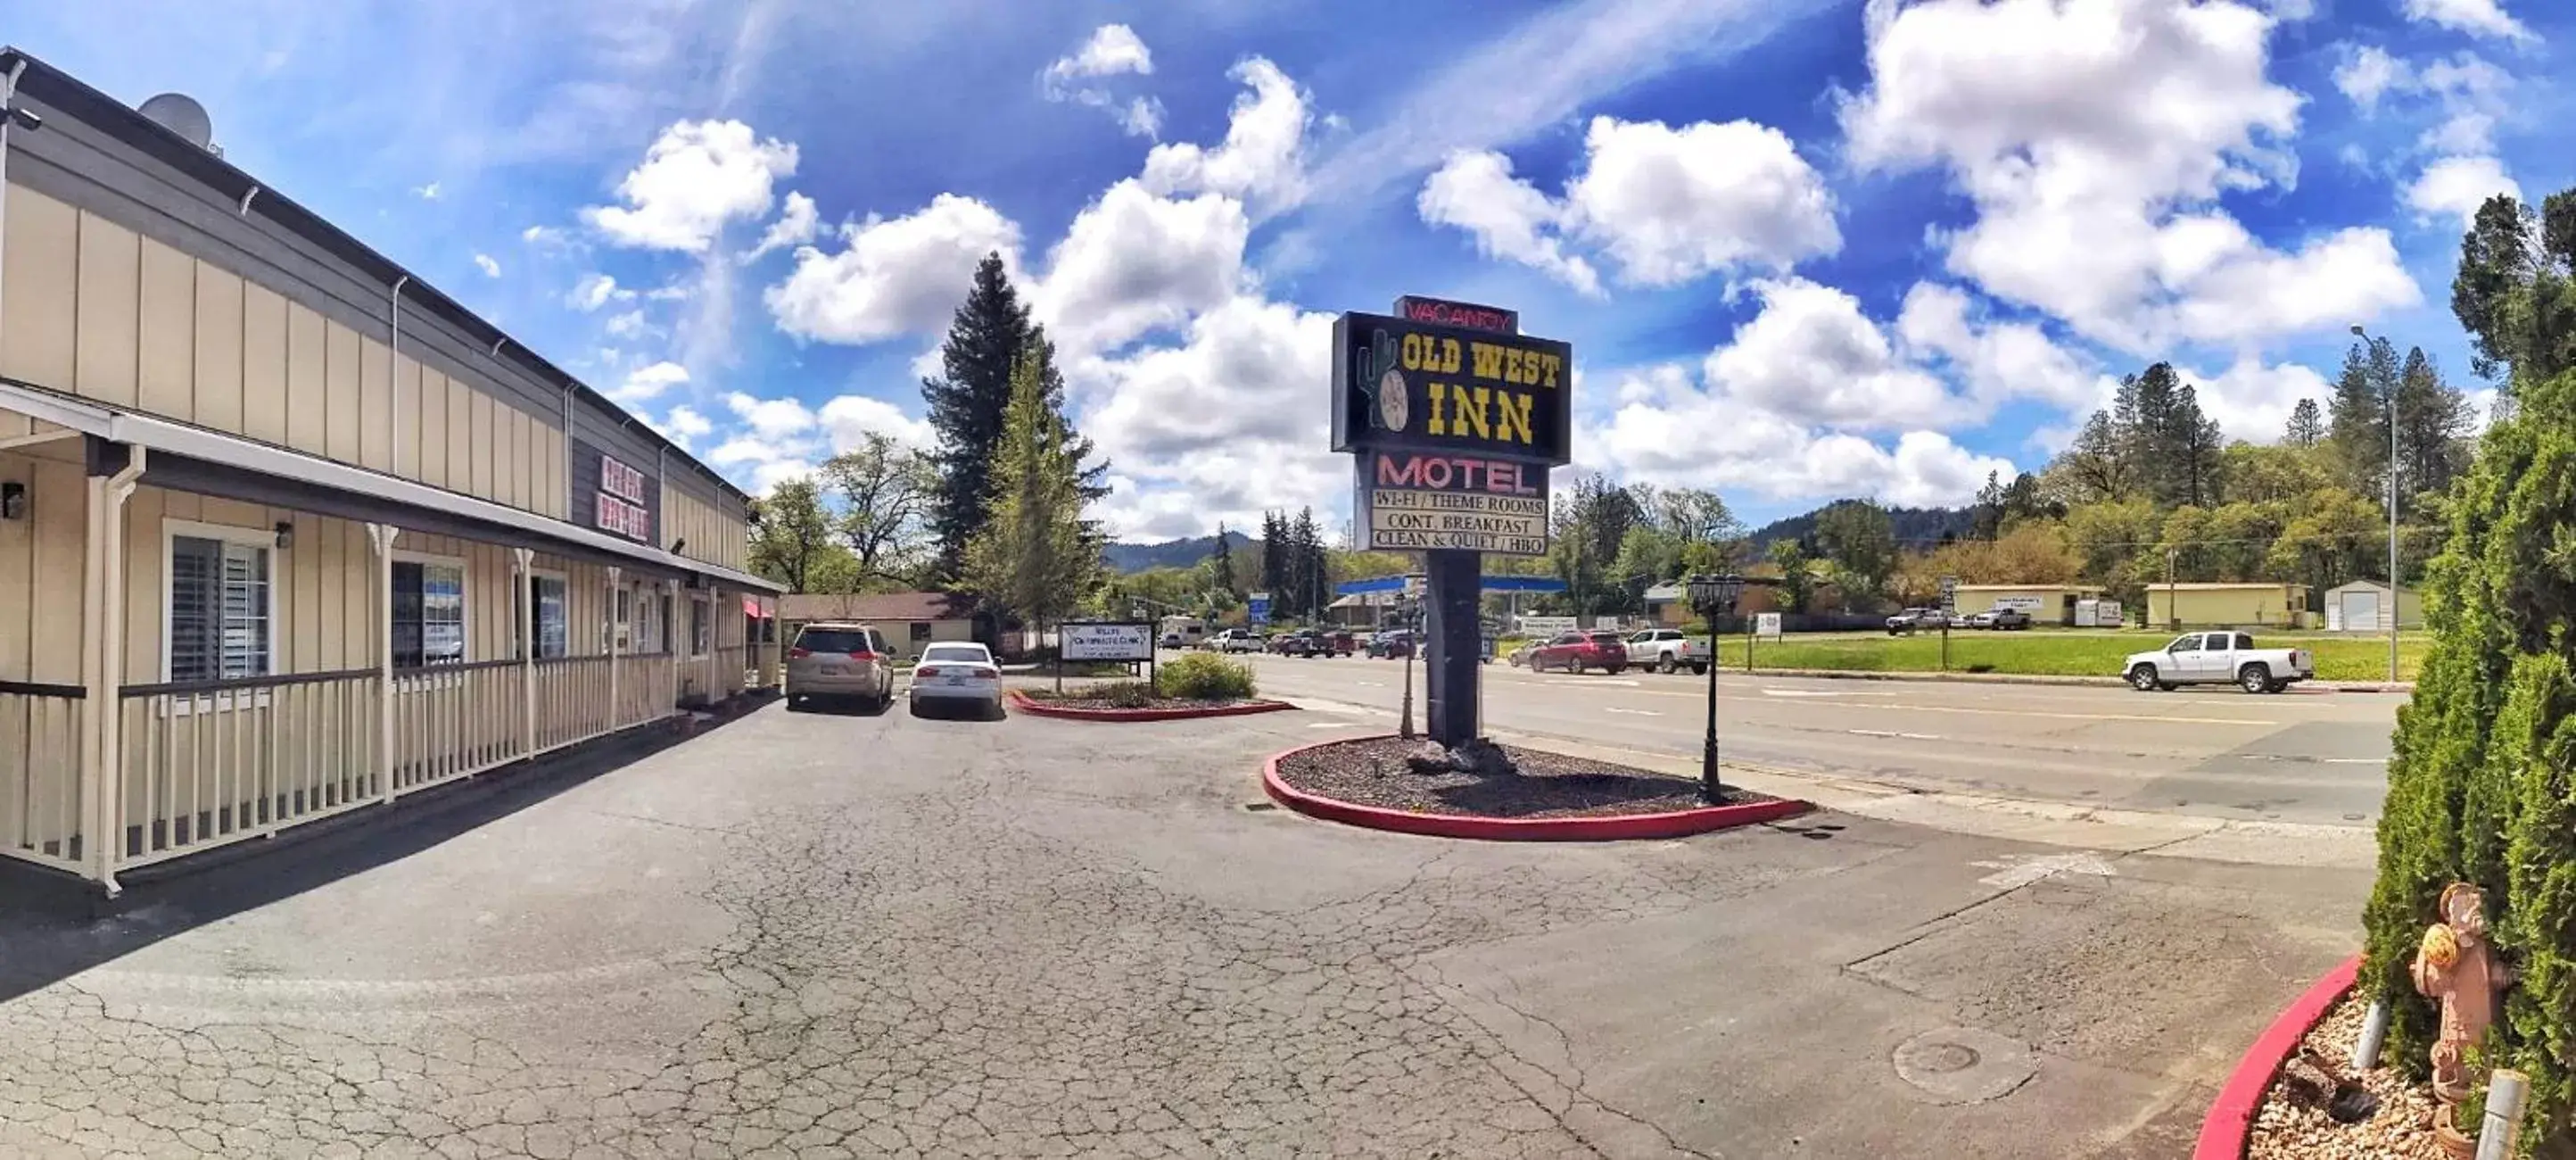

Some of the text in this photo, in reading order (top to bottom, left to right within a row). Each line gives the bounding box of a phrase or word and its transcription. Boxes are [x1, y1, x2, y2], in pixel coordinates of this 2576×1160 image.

[1406, 302, 1512, 330] VACANCY
[1402, 333, 1560, 388] OLD WEST
[1429, 382, 1532, 444] INN
[1378, 455, 1537, 494] MOTEL
[1376, 492, 1416, 507] WI-FI
[1432, 493, 1484, 510] THEME
[1489, 497, 1543, 515] ROOMS
[1388, 513, 1532, 534] CONT. BREAKFAST
[1376, 532, 1429, 547] CLEAN
[1433, 534, 1446, 547] &
[1450, 534, 1498, 550] QUIET
[1510, 537, 1542, 552] HBO
